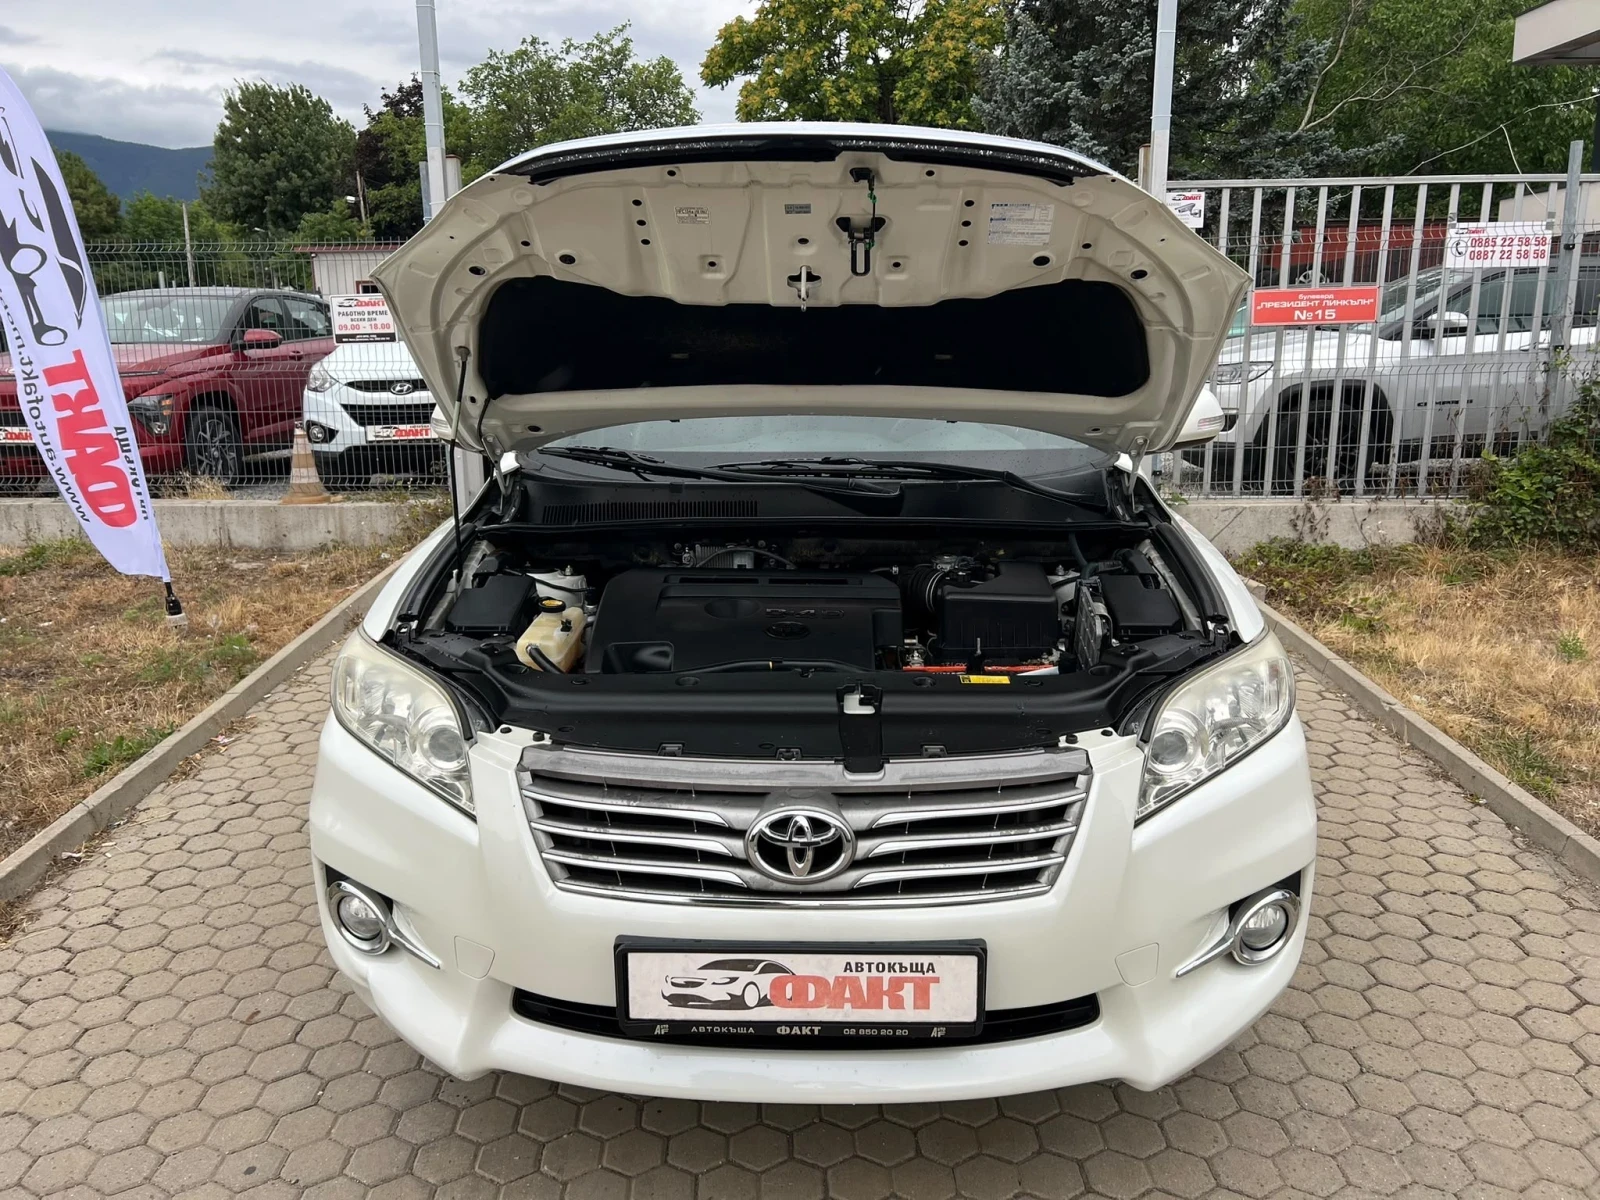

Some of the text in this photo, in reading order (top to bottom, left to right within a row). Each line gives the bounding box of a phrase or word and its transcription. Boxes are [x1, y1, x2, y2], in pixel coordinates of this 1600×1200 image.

[1470, 236, 1548, 248] 0885 22 58 58
[1469, 249, 1546, 260] 0887 22 58 58
[338, 323, 361, 331] 09.00
[369, 322, 391, 330] 18.00
[5, 431, 33, 440] ФАК
[395, 428, 431, 437] ФАКТ
[843, 961, 936, 975] АВТОКЪЩА
[769, 974, 941, 1010] ФАКТ
[690, 1026, 755, 1034] АВТОКЪЩА
[776, 1025, 822, 1035] ФАКТ
[880, 1028, 893, 1036] 20
[895, 1028, 909, 1036] 20
